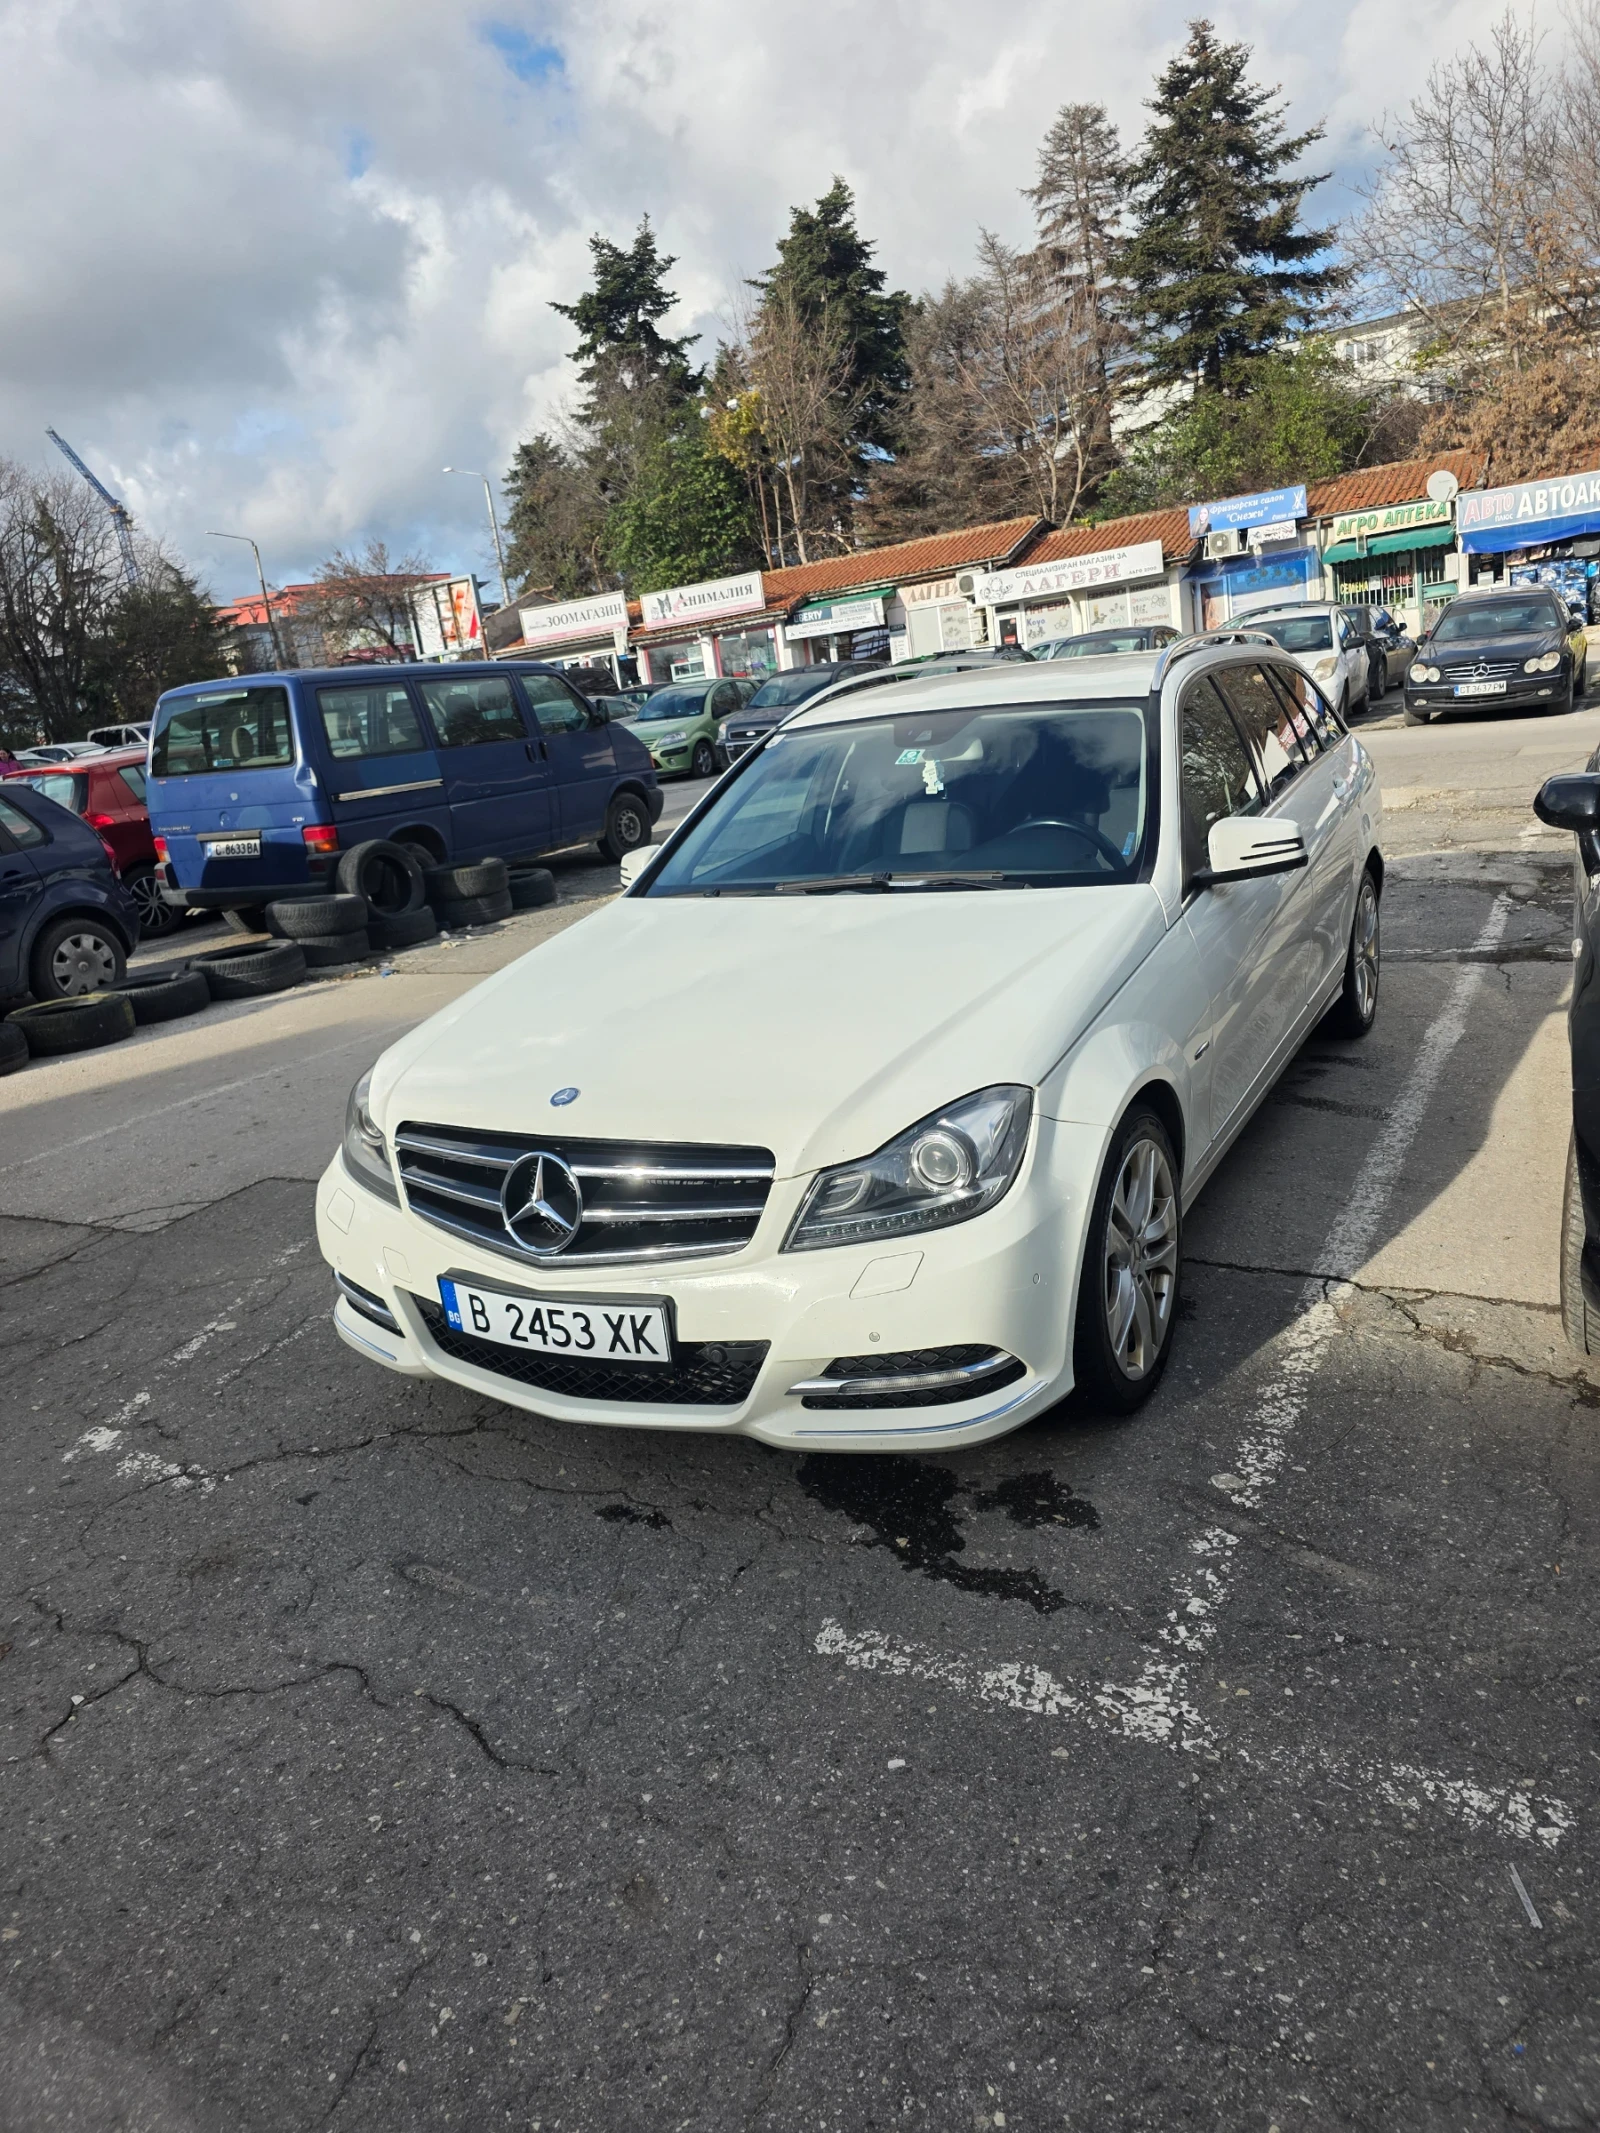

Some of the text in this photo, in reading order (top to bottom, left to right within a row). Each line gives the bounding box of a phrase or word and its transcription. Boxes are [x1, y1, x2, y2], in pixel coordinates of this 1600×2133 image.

[1210, 494, 1284, 514] Фризьорски салон
[1463, 492, 1515, 526] АВТО
[1337, 502, 1447, 536] АГРО АПТЕКА
[1014, 551, 1127, 580] СПЕЦИАЛИЗИРАН МАГАЗИН ЗА
[1020, 562, 1121, 594] ЛАГЕРИ
[908, 582, 958, 604] ЛАГЕР
[546, 603, 622, 628] ЗООМАГАЗИН
[793, 610, 823, 623] LIBERTY
[1026, 618, 1046, 629] Koyo
[215, 843, 259, 856] C 8633 BA
[448, 1310, 461, 1323] BG
[468, 1293, 660, 1355] B 2453 XK
